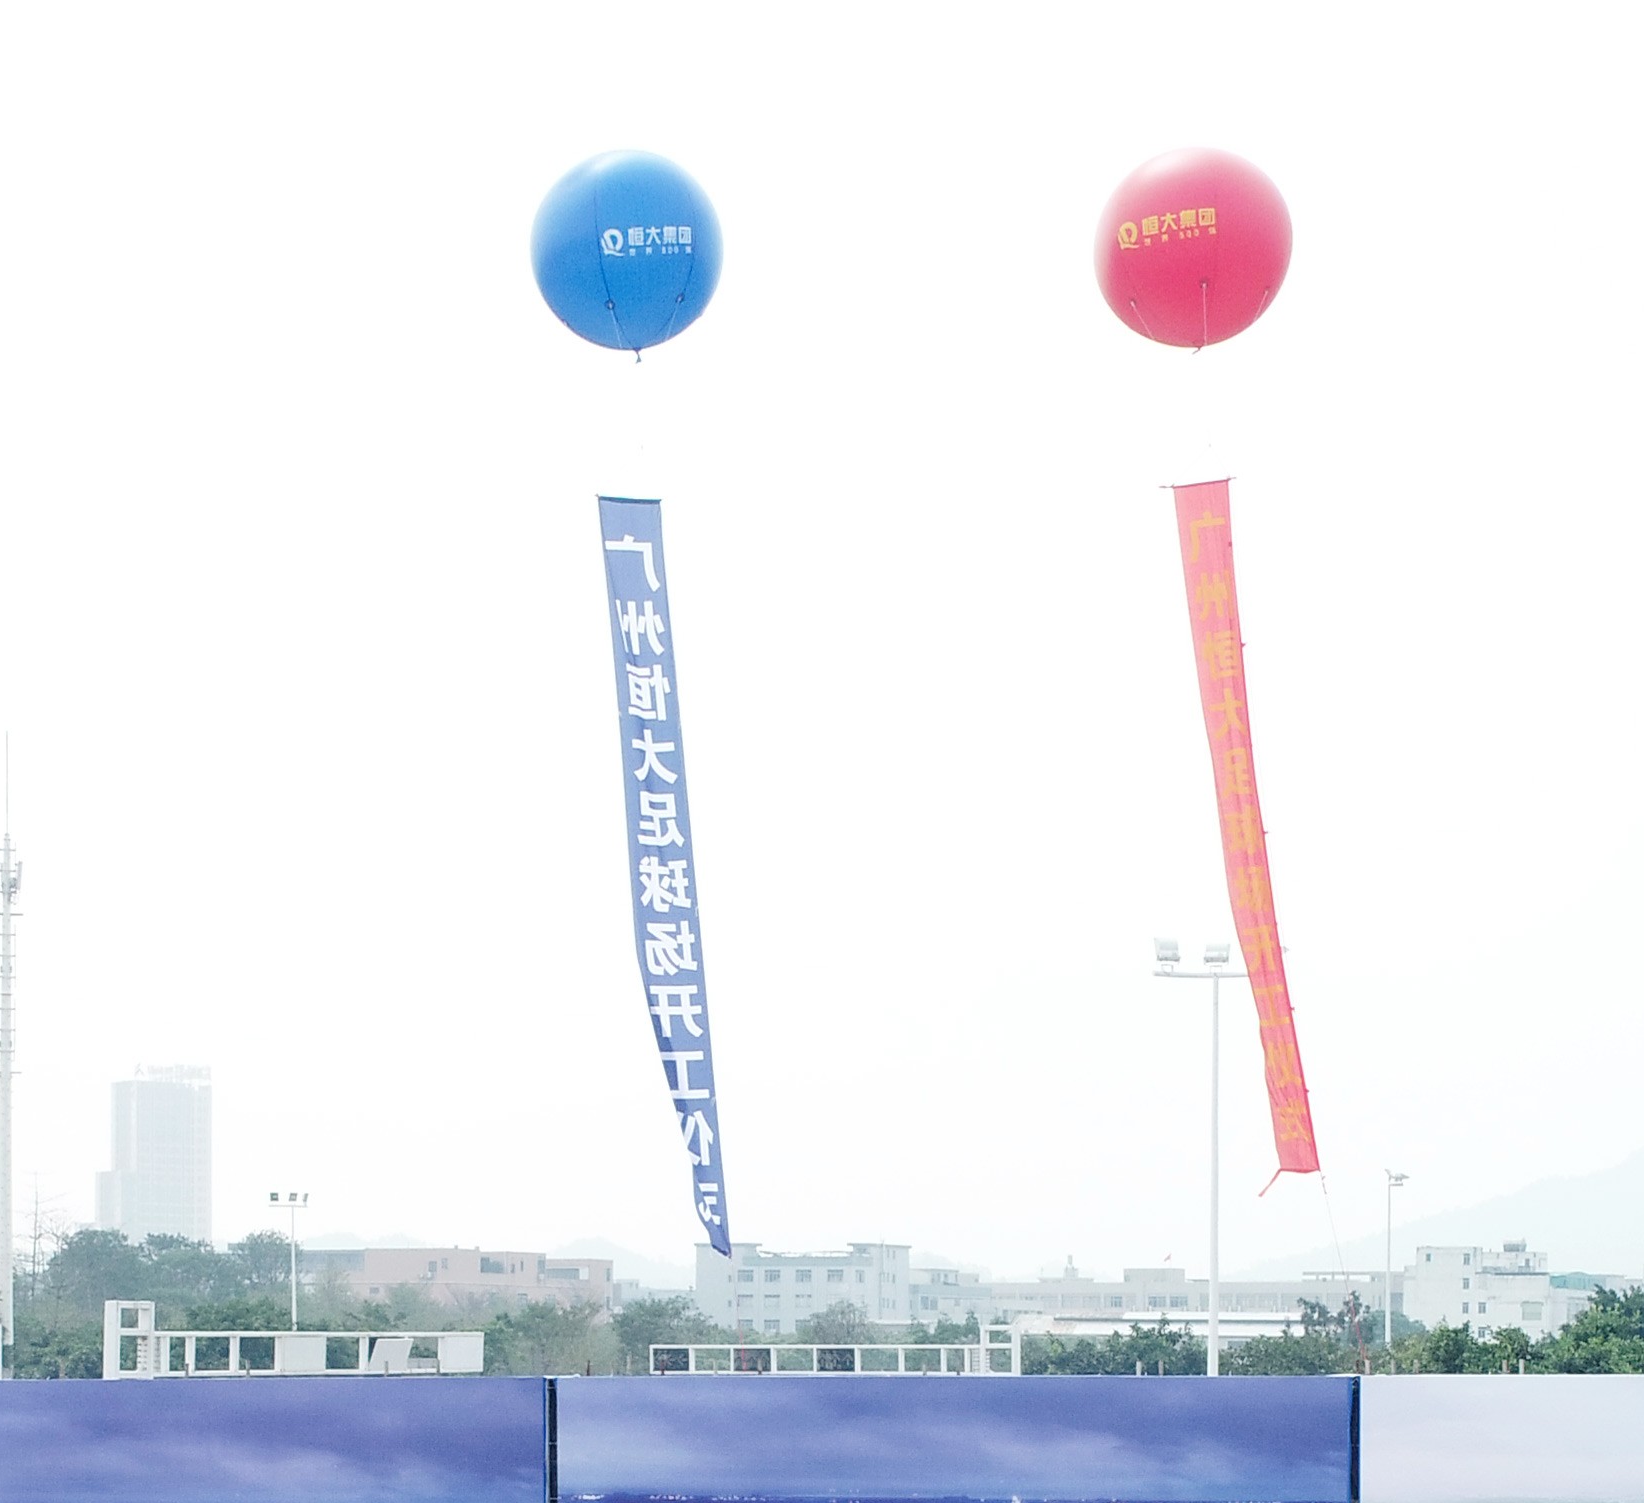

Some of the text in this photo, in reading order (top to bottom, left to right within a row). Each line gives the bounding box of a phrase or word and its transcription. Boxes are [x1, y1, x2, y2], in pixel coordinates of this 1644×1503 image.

[627, 226, 693, 246] 恒大集团
[1142, 207, 1216, 236] 恒大集团
[1189, 510, 1313, 1143] 广州恒大足球场开工仪式
